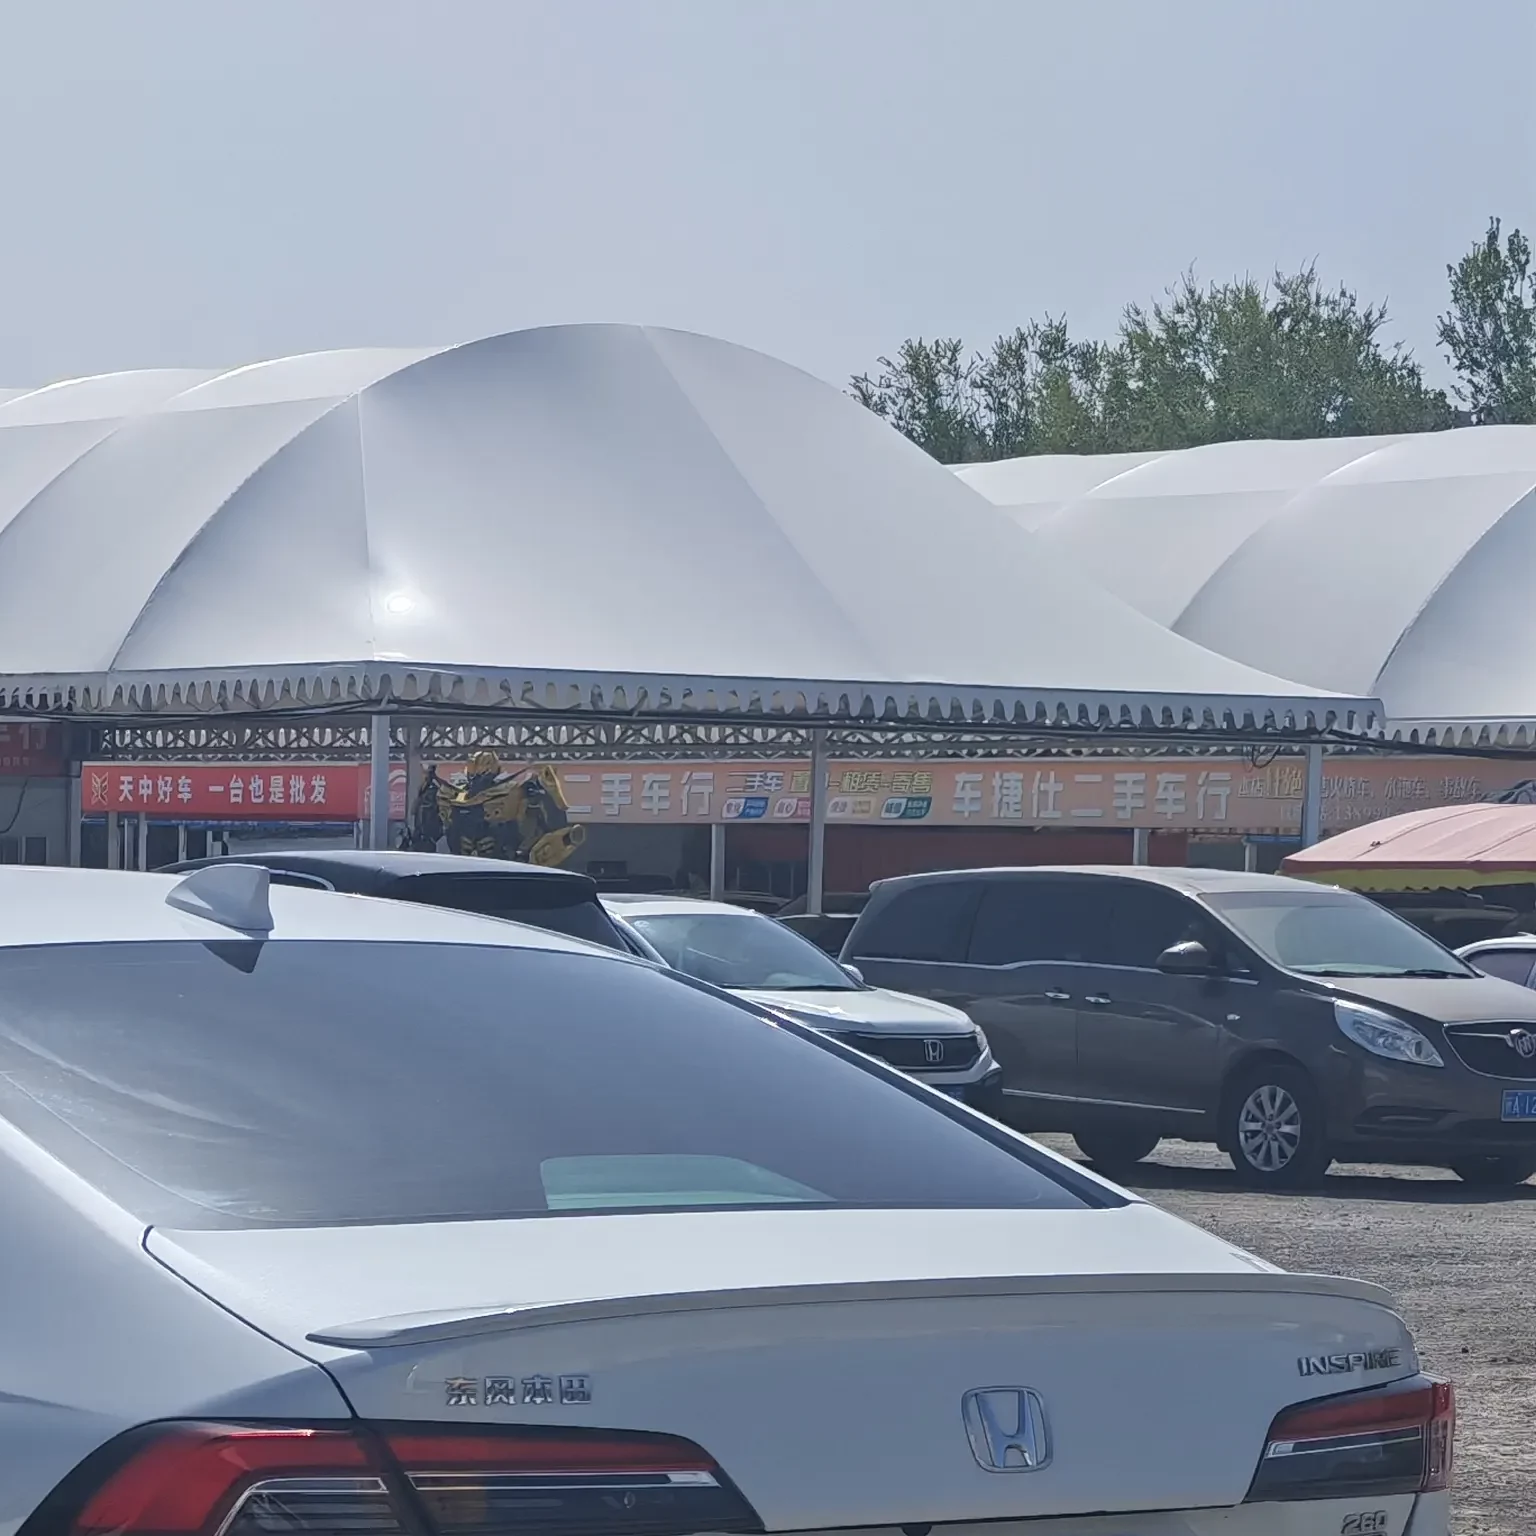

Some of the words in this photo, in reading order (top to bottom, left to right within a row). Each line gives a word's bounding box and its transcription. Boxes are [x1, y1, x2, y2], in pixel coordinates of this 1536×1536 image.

[119, 775, 192, 804] 天中好车
[208, 775, 327, 804] 一台也是批发
[565, 771, 715, 816] 二手车行
[725, 771, 785, 793] 二手车
[953, 770, 1232, 820] 车捷仕二手车行
[1297, 1348, 1401, 1376] INSPIRE
[445, 1374, 592, 1406] 东风本田
